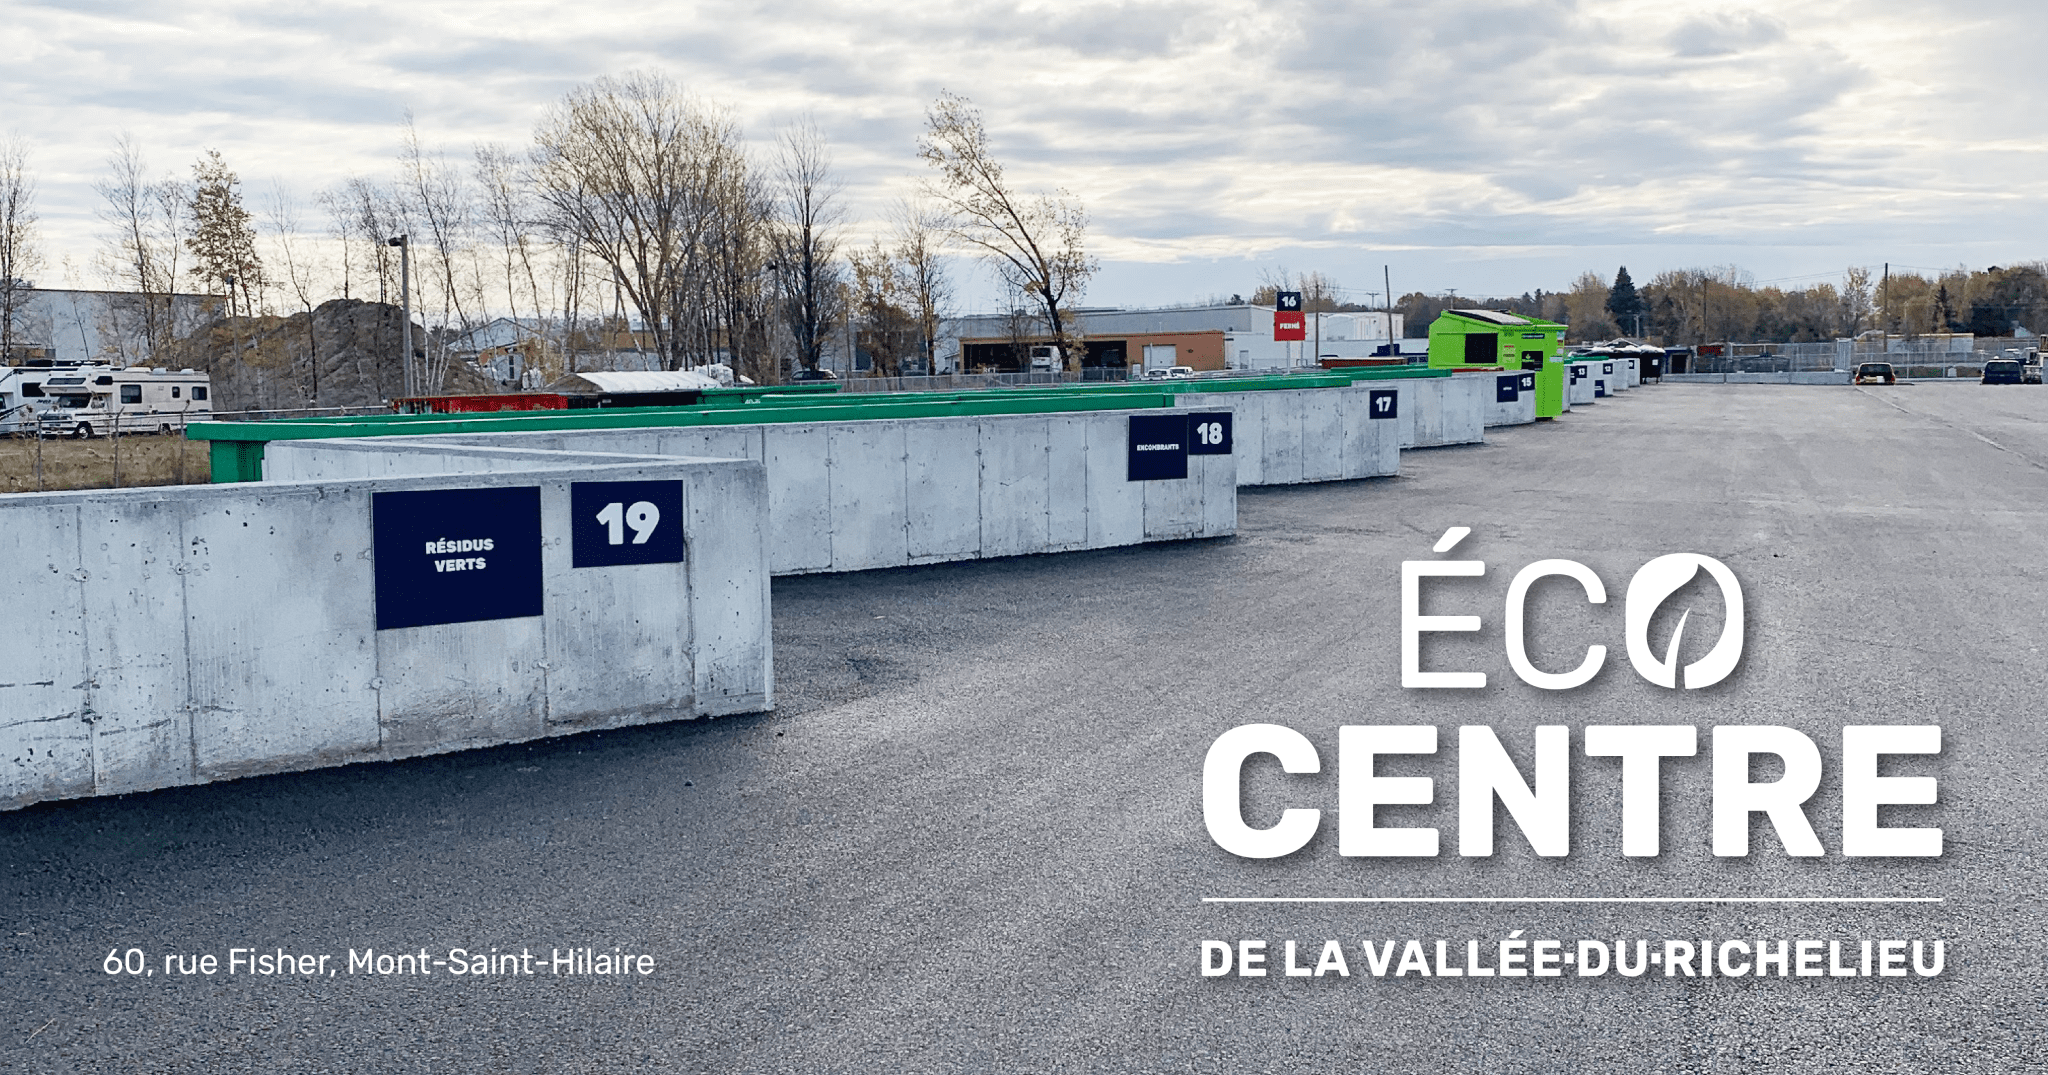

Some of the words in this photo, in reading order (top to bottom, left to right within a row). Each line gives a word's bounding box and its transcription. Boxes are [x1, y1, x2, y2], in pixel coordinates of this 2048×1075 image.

[1281, 296, 1297, 307] 16
[1521, 377, 1532, 387] 15
[1375, 396, 1392, 412] 17
[1196, 422, 1223, 445] 18
[1136, 443, 1180, 451] ENCOMBRANTS
[596, 501, 660, 545] 19
[425, 537, 494, 555] RÉSIDUS
[434, 557, 487, 573] VERTS
